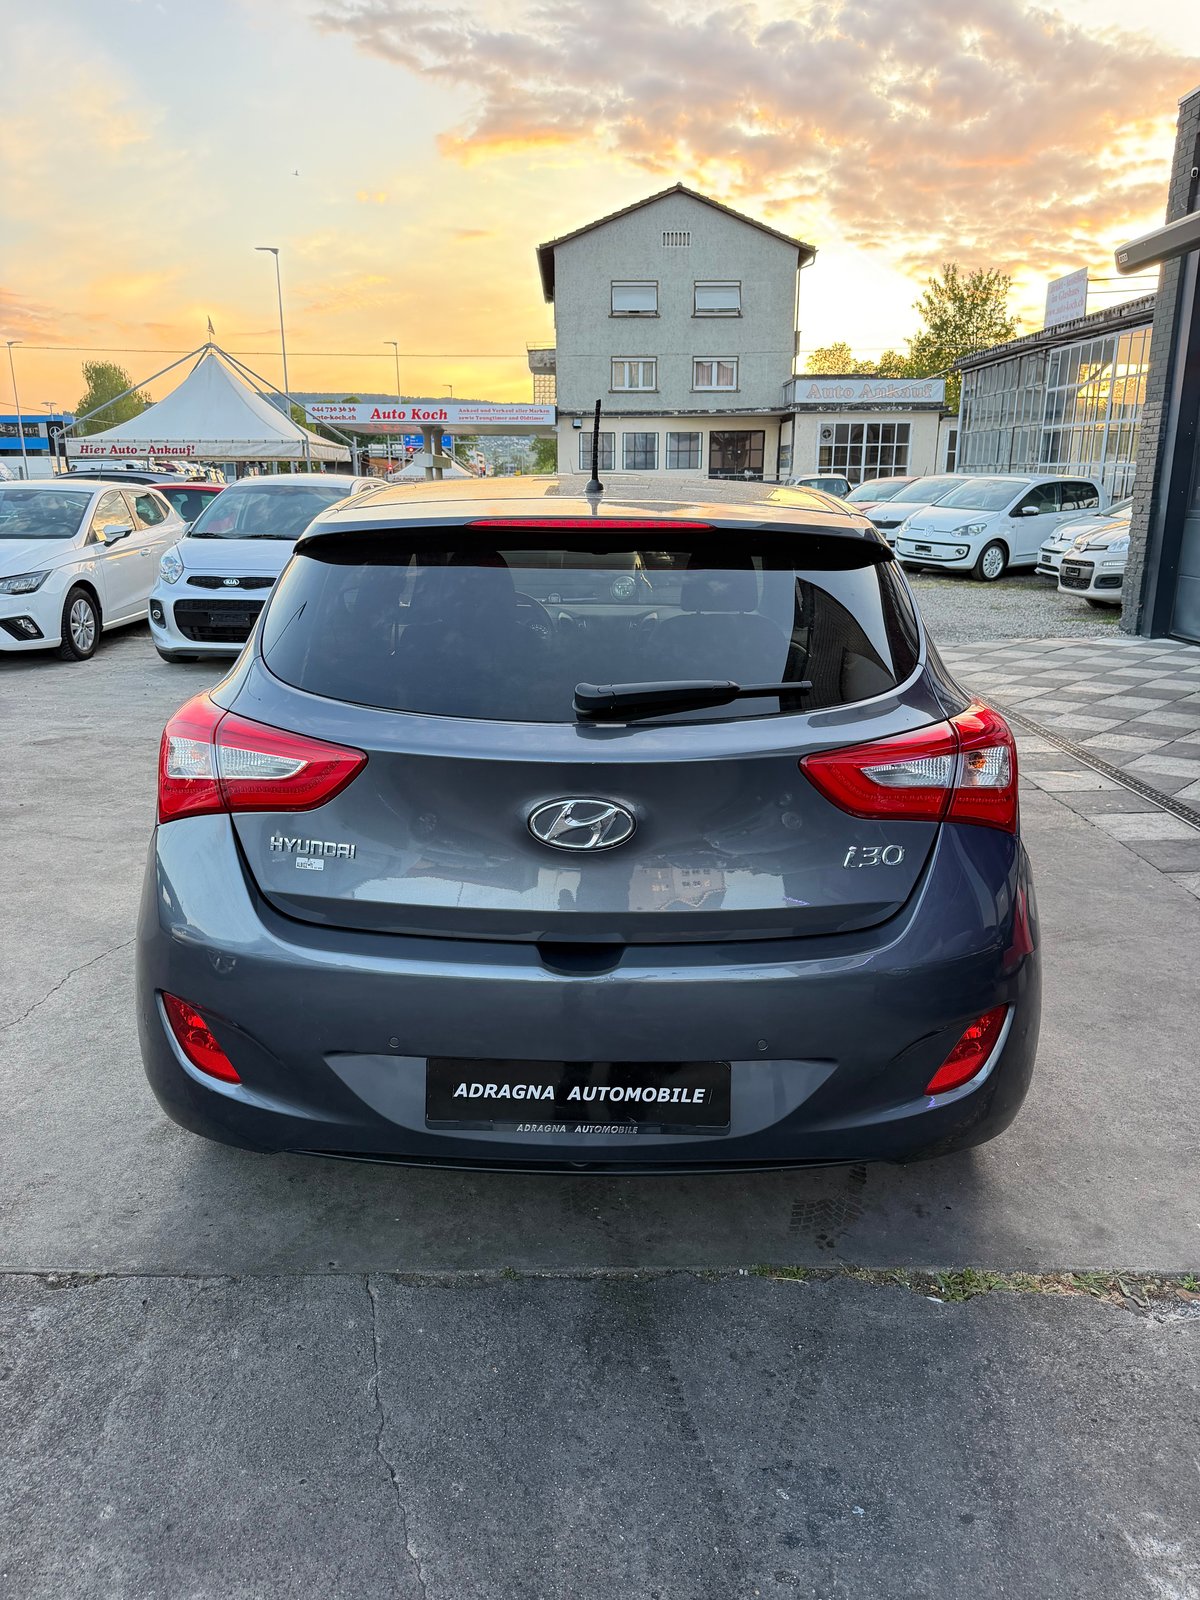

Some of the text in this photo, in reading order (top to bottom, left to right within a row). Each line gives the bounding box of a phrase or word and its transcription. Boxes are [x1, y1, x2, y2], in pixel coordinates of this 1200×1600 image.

[806, 383, 933, 399] Auto Ankauf
[370, 408, 448, 420] Auto Koch
[80, 445, 106, 454] Hier
[270, 836, 356, 859] HYUNDAI
[843, 844, 905, 868] i30
[453, 1082, 706, 1104] ADRAGNA AUTOMOBILE
[516, 1123, 639, 1134] ADRAGNA AUTOMOBILE
